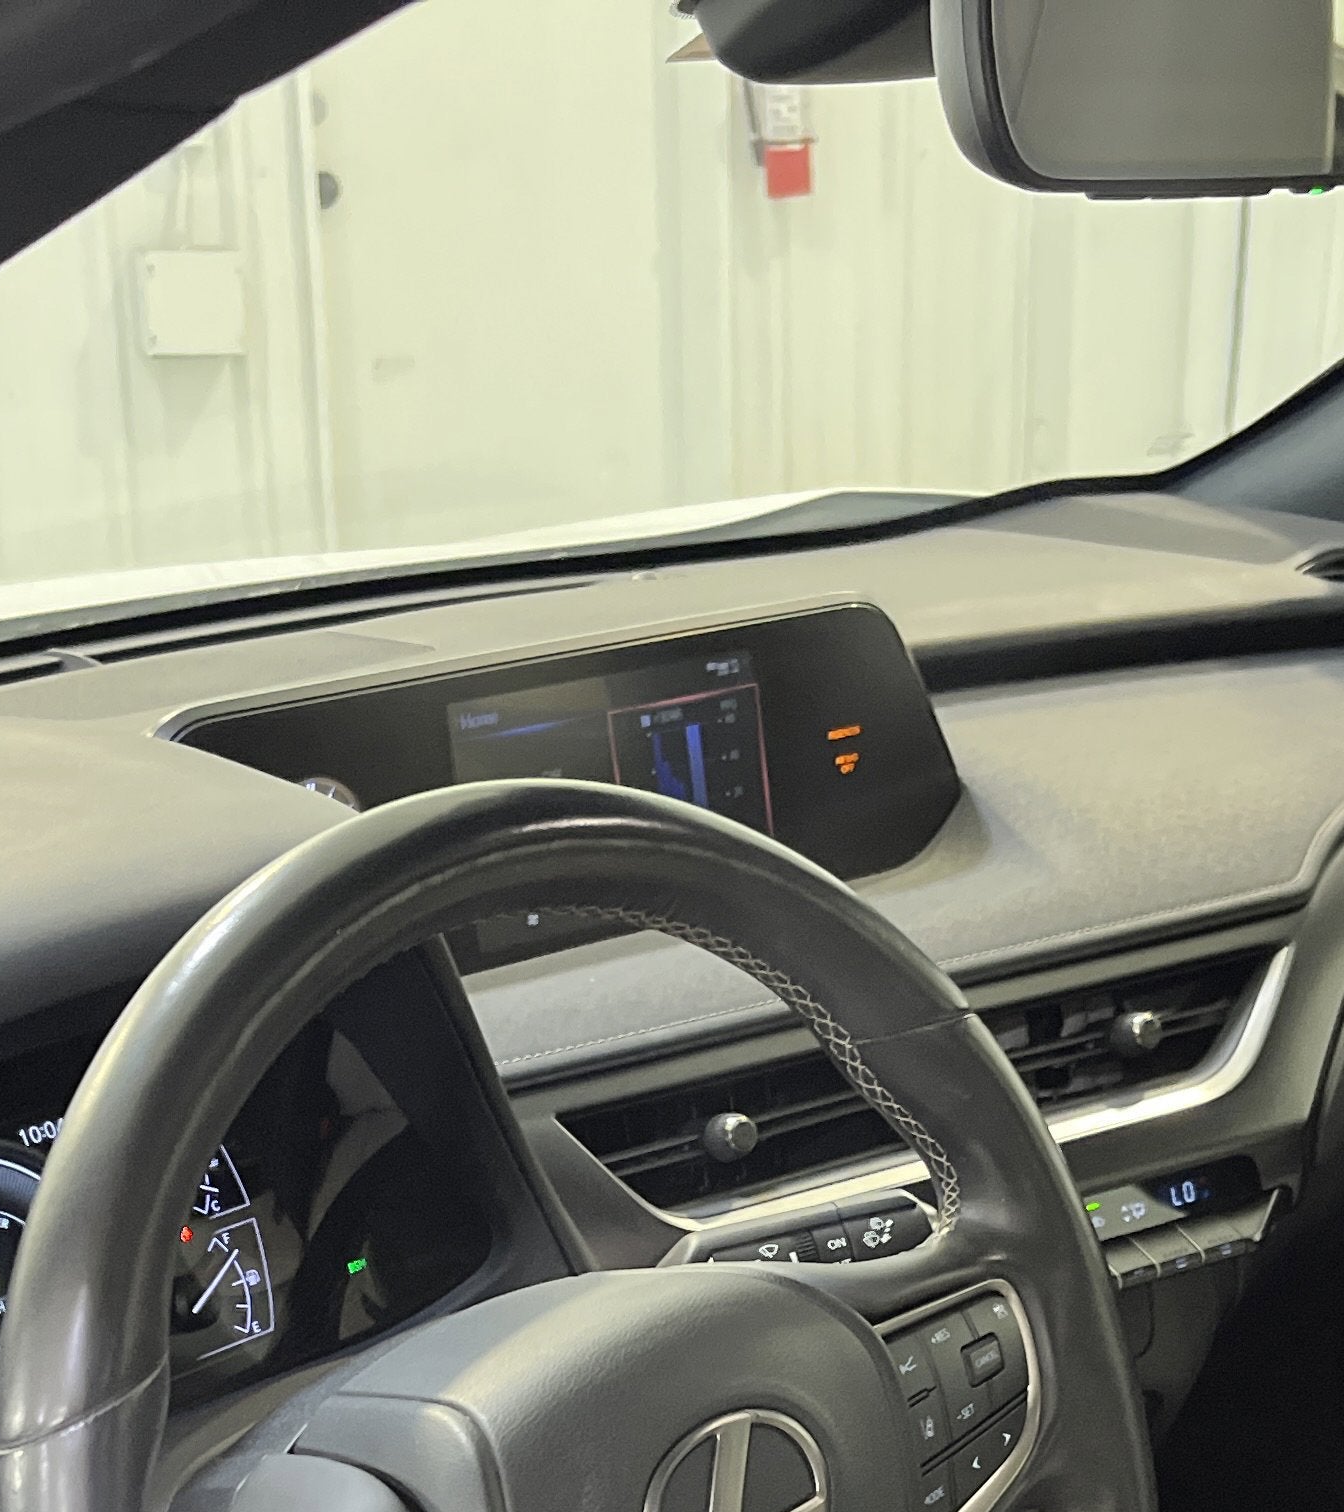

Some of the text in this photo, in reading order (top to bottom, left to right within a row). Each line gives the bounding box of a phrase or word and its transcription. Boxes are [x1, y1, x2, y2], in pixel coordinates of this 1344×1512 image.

[222, 1232, 231, 1245] F
[826, 1237, 847, 1251] ON
[251, 1320, 262, 1334] E
